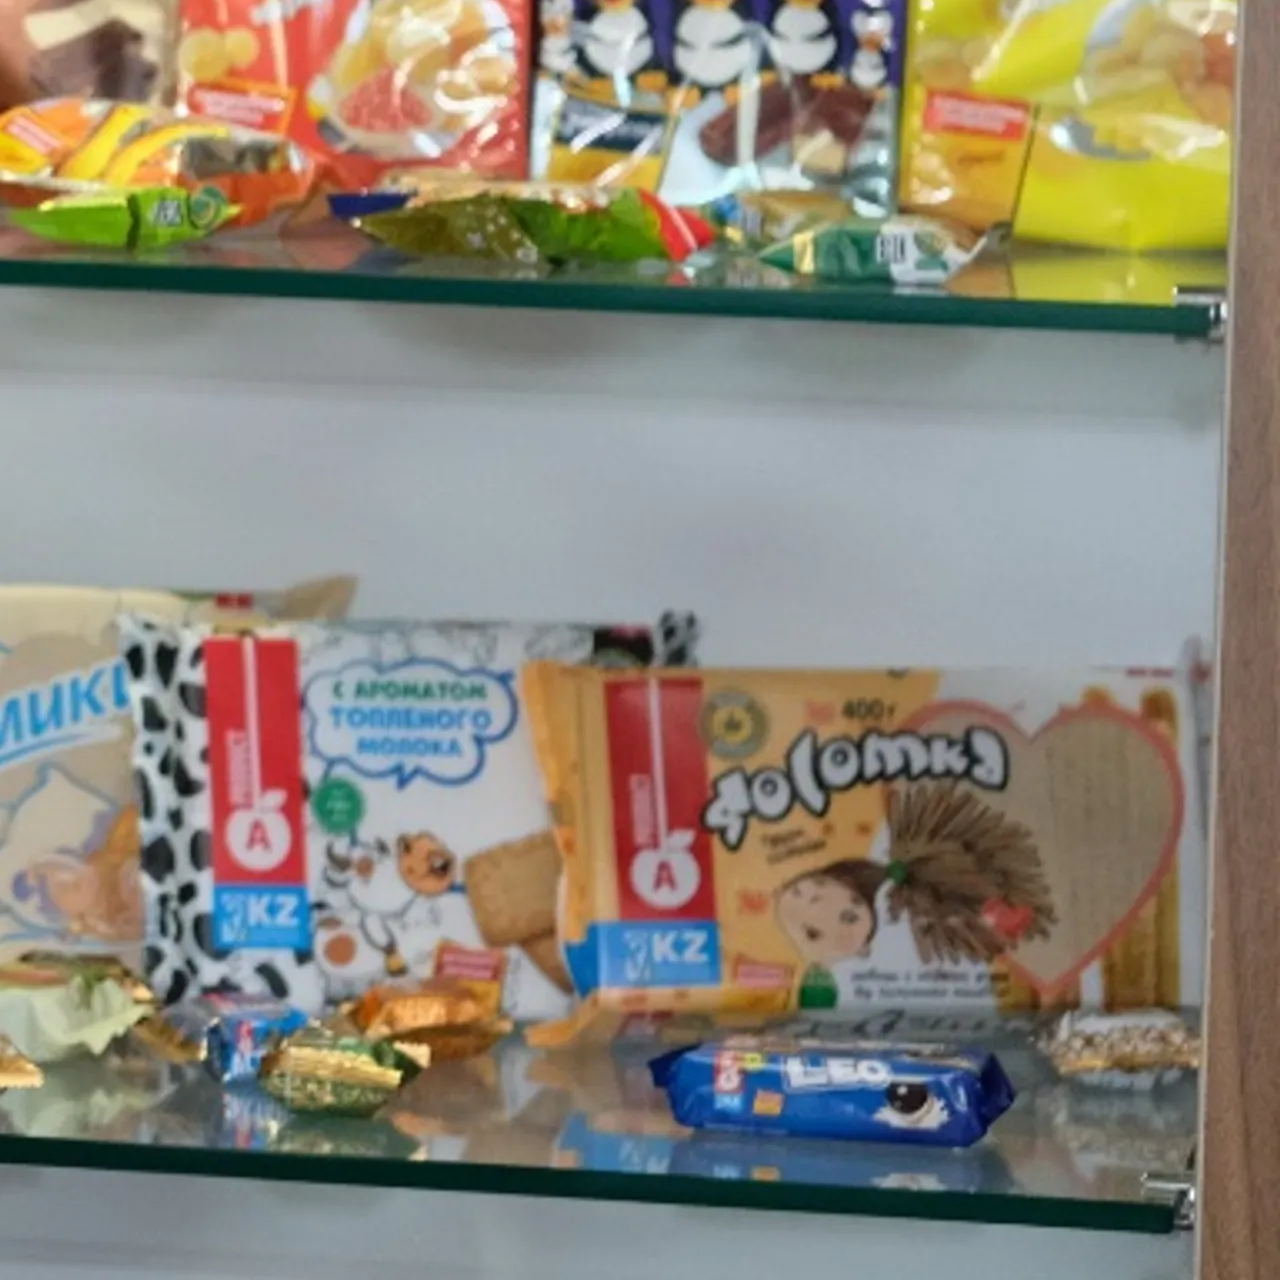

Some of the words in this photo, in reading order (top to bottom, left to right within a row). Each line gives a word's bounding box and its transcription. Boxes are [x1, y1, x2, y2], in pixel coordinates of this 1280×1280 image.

[247, 894, 302, 924] KZ
[652, 929, 710, 963] KZ
[785, 1055, 890, 1087] LEO
